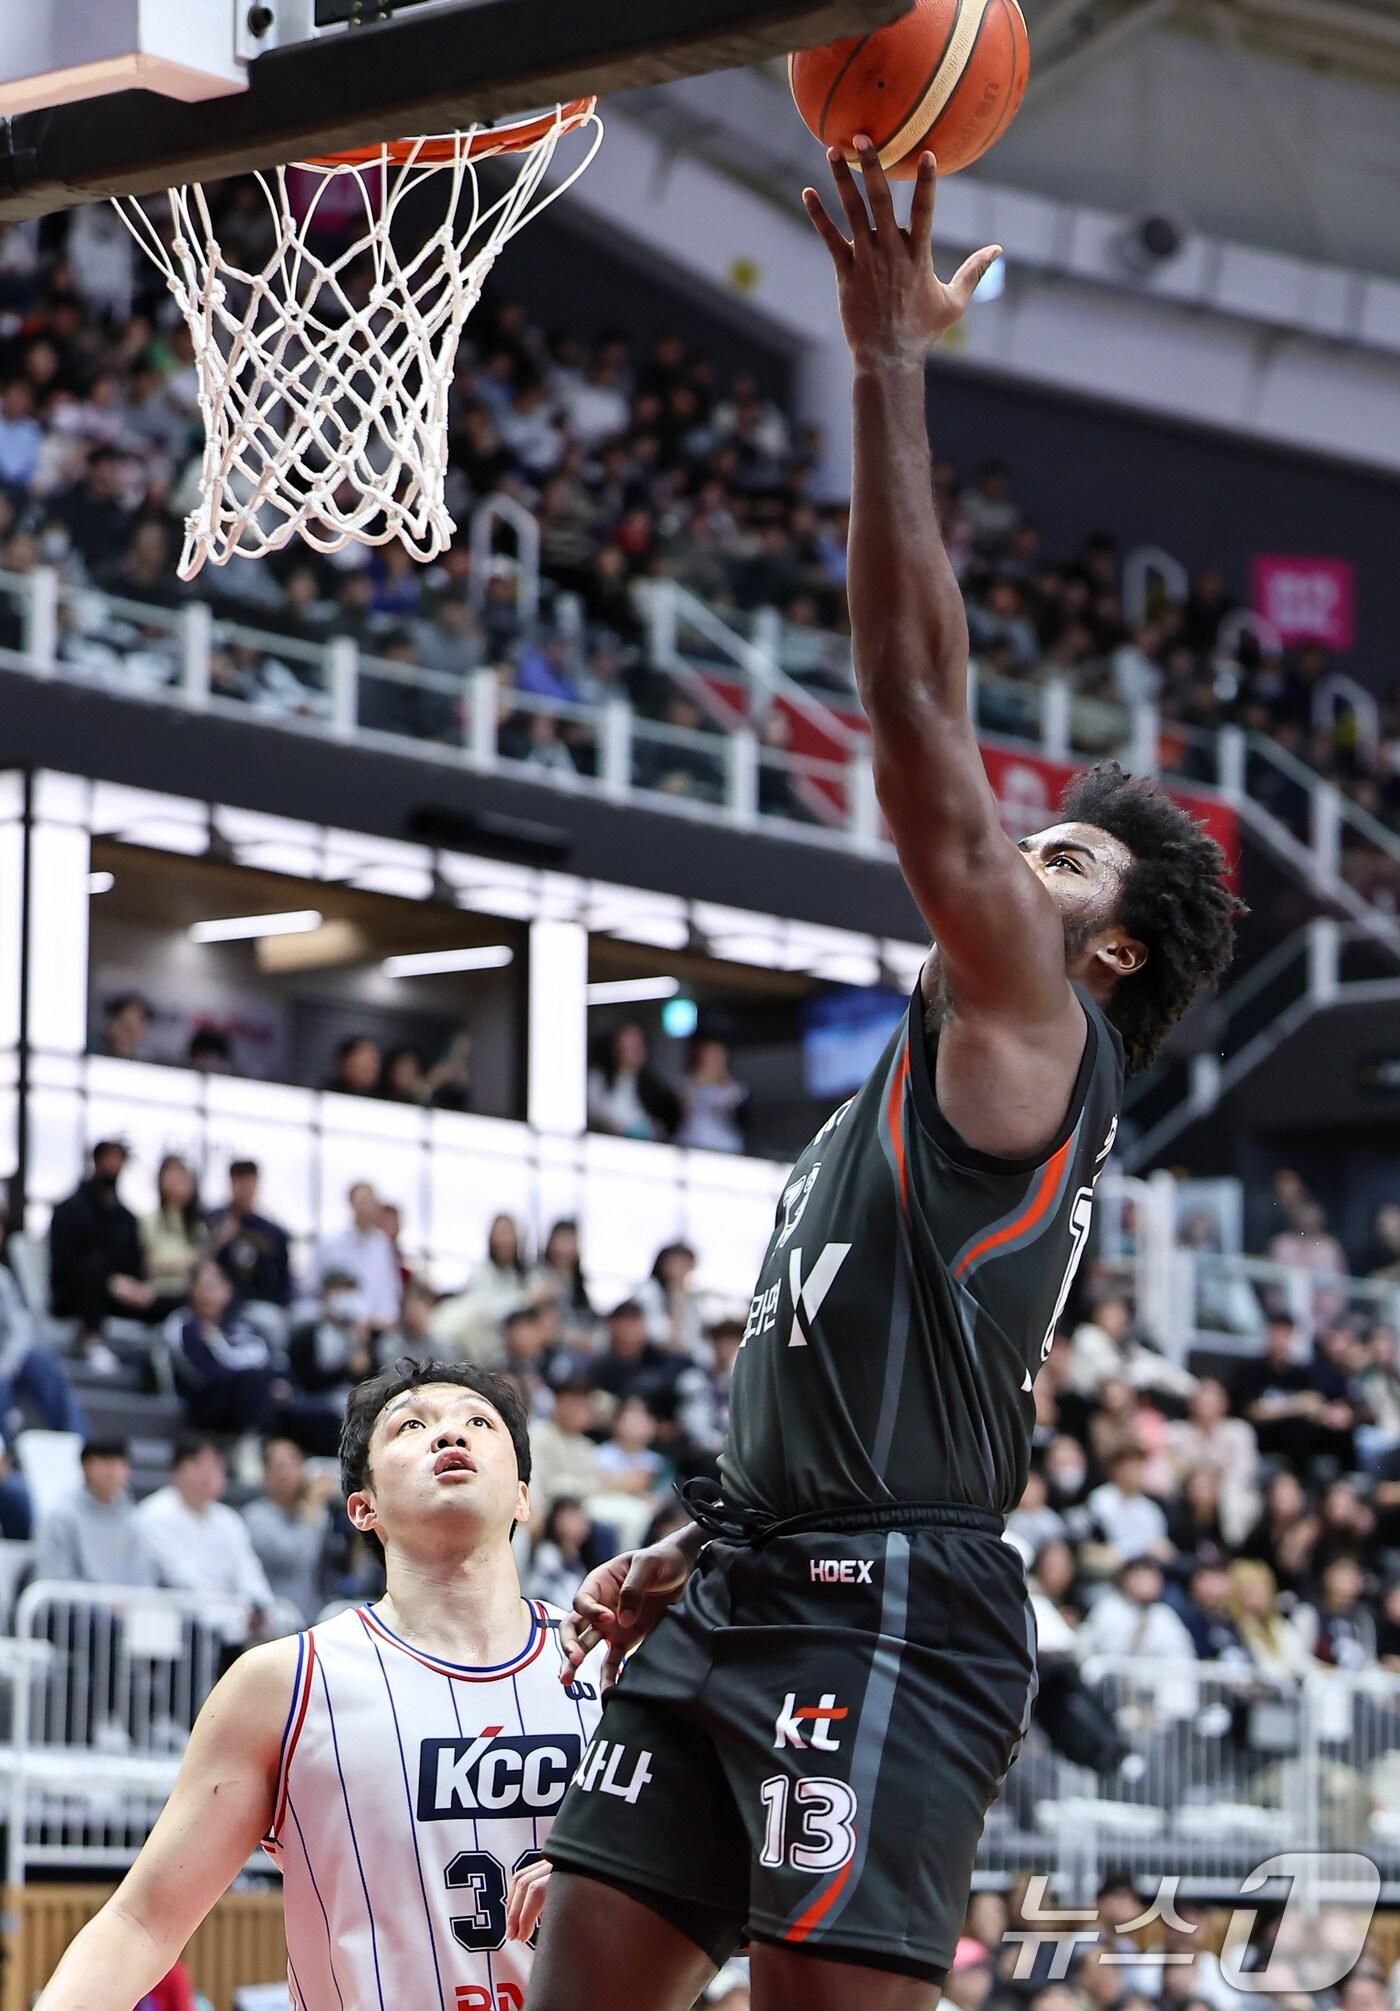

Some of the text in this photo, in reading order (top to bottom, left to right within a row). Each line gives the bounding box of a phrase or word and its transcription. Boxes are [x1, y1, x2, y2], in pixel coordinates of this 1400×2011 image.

[773, 1692, 849, 1752] kt
[434, 1725, 568, 1811] KCC
[759, 1774, 858, 1874] 13
